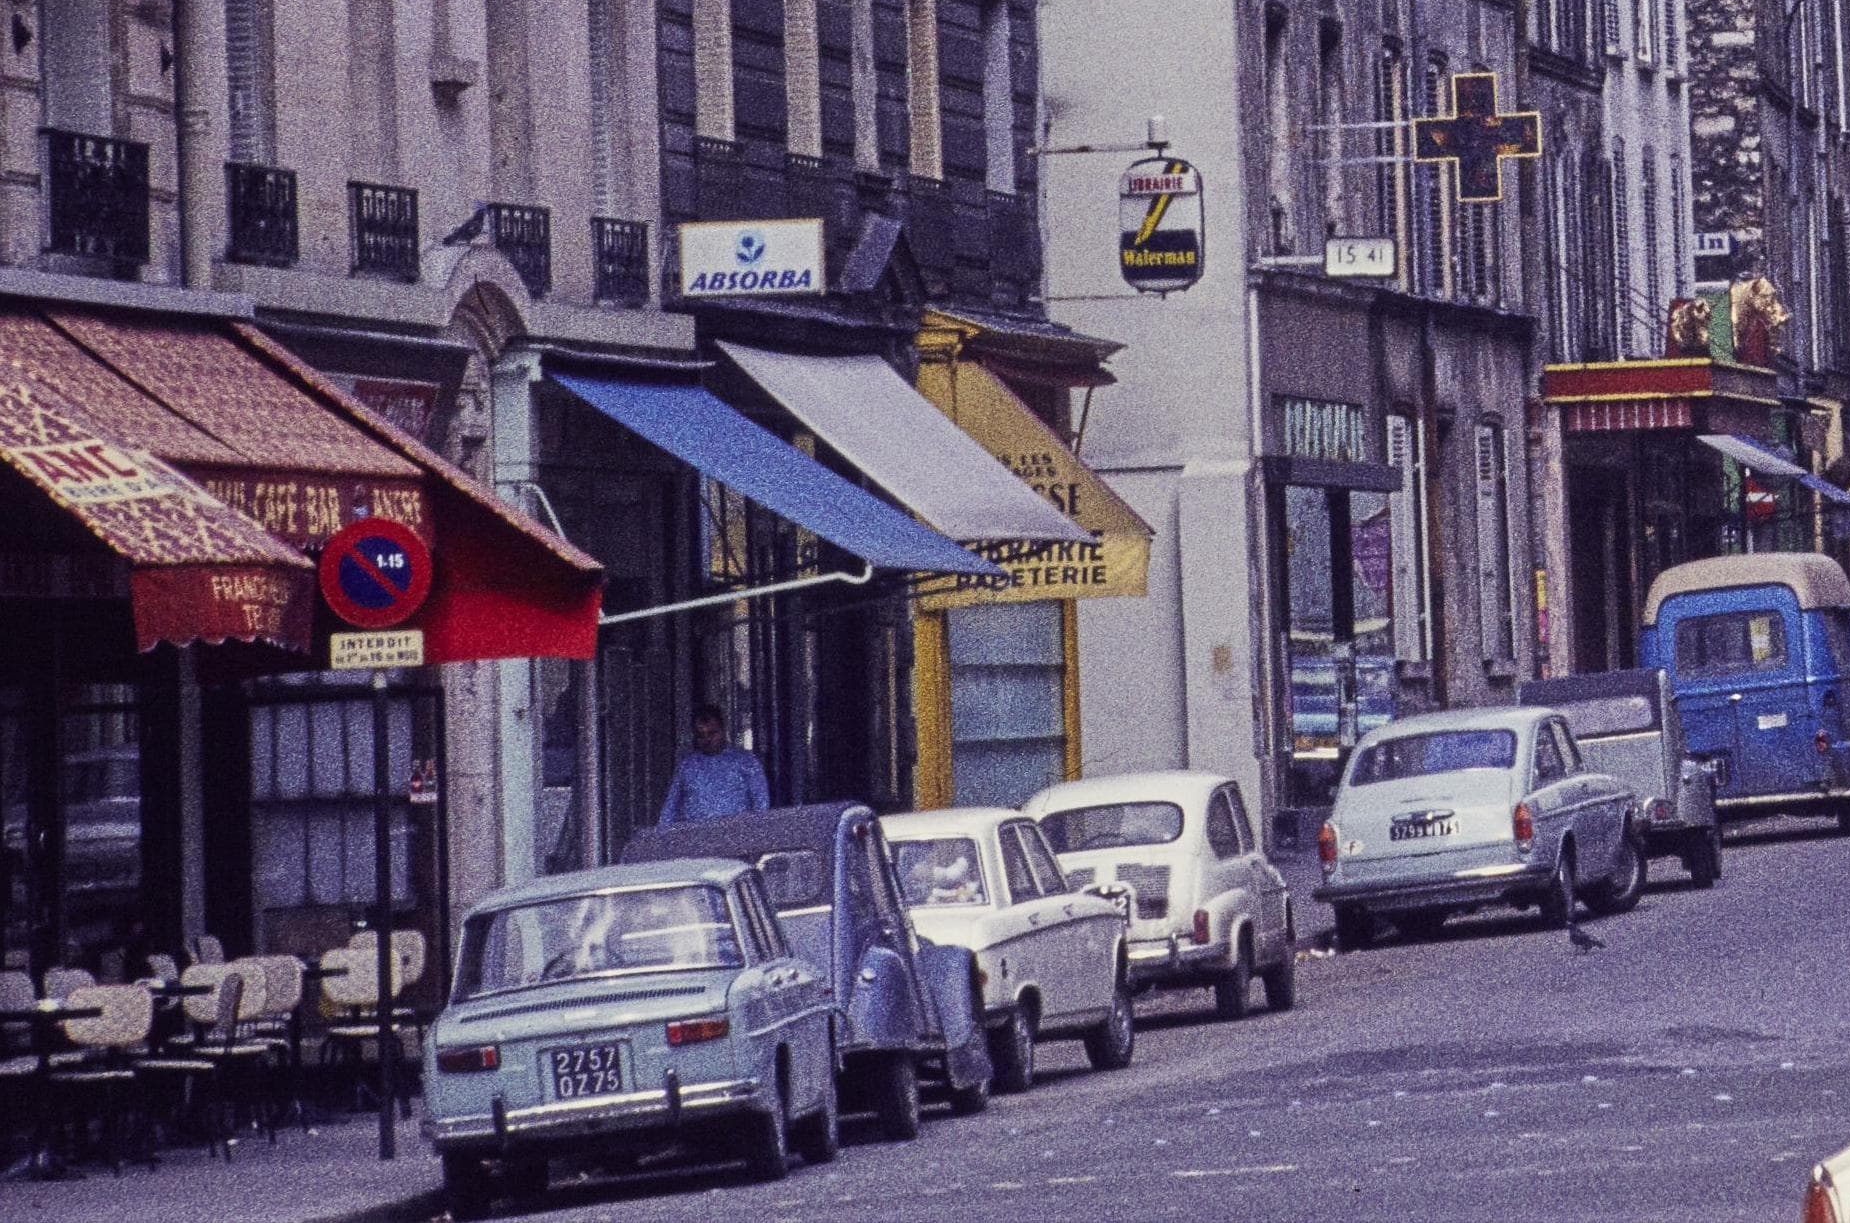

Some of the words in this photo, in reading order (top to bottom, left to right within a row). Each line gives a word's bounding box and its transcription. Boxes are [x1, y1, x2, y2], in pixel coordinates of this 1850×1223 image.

[1128, 176, 1184, 191] LIBRAIRIE
[1122, 249, 1196, 266] Waterman
[688, 267, 812, 293] ABSORBA
[376, 553, 404, 568] 1-15
[340, 636, 411, 650] INTERDIT
[556, 1047, 616, 1074] 2757
